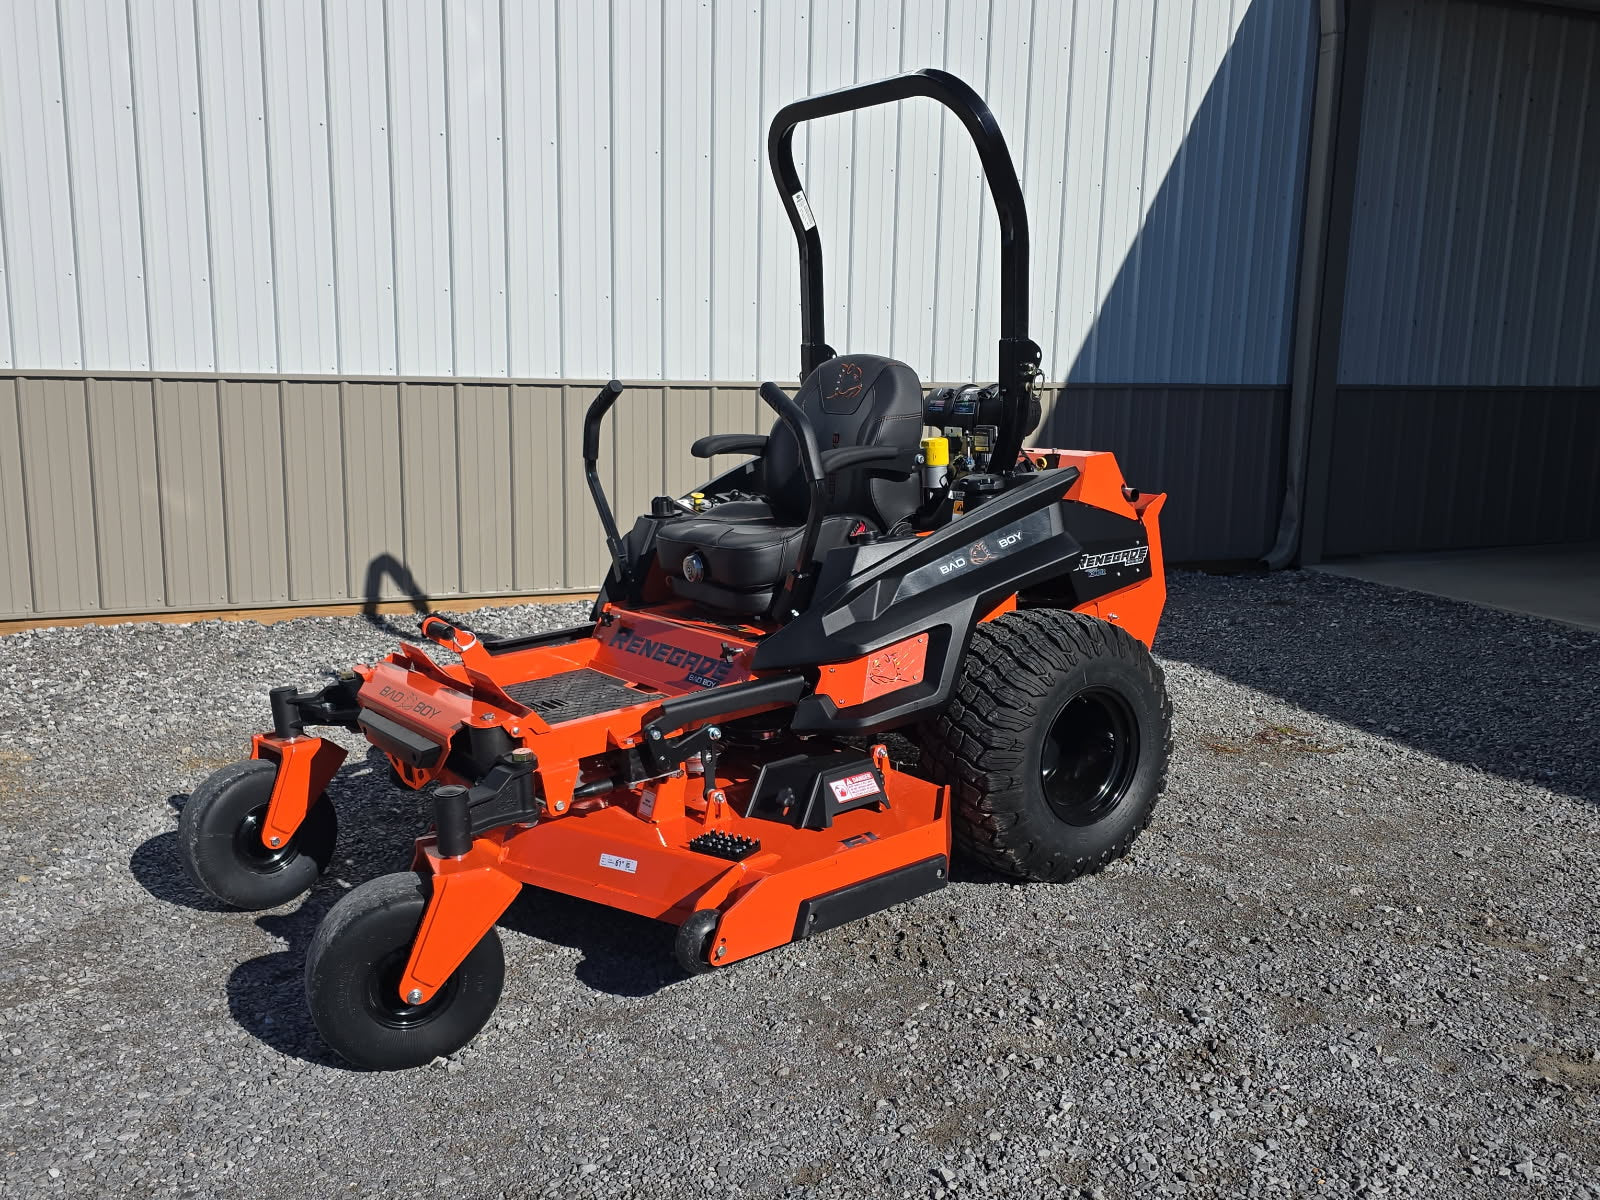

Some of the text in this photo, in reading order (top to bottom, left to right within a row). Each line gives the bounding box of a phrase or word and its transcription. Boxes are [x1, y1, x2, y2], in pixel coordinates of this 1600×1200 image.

[940, 532, 1022, 575] BAD BOY
[1074, 545, 1149, 571] RENEGADE
[608, 626, 734, 681] RENEGADE
[688, 673, 717, 688] BAD BOY
[379, 685, 442, 719] BAD BOY
